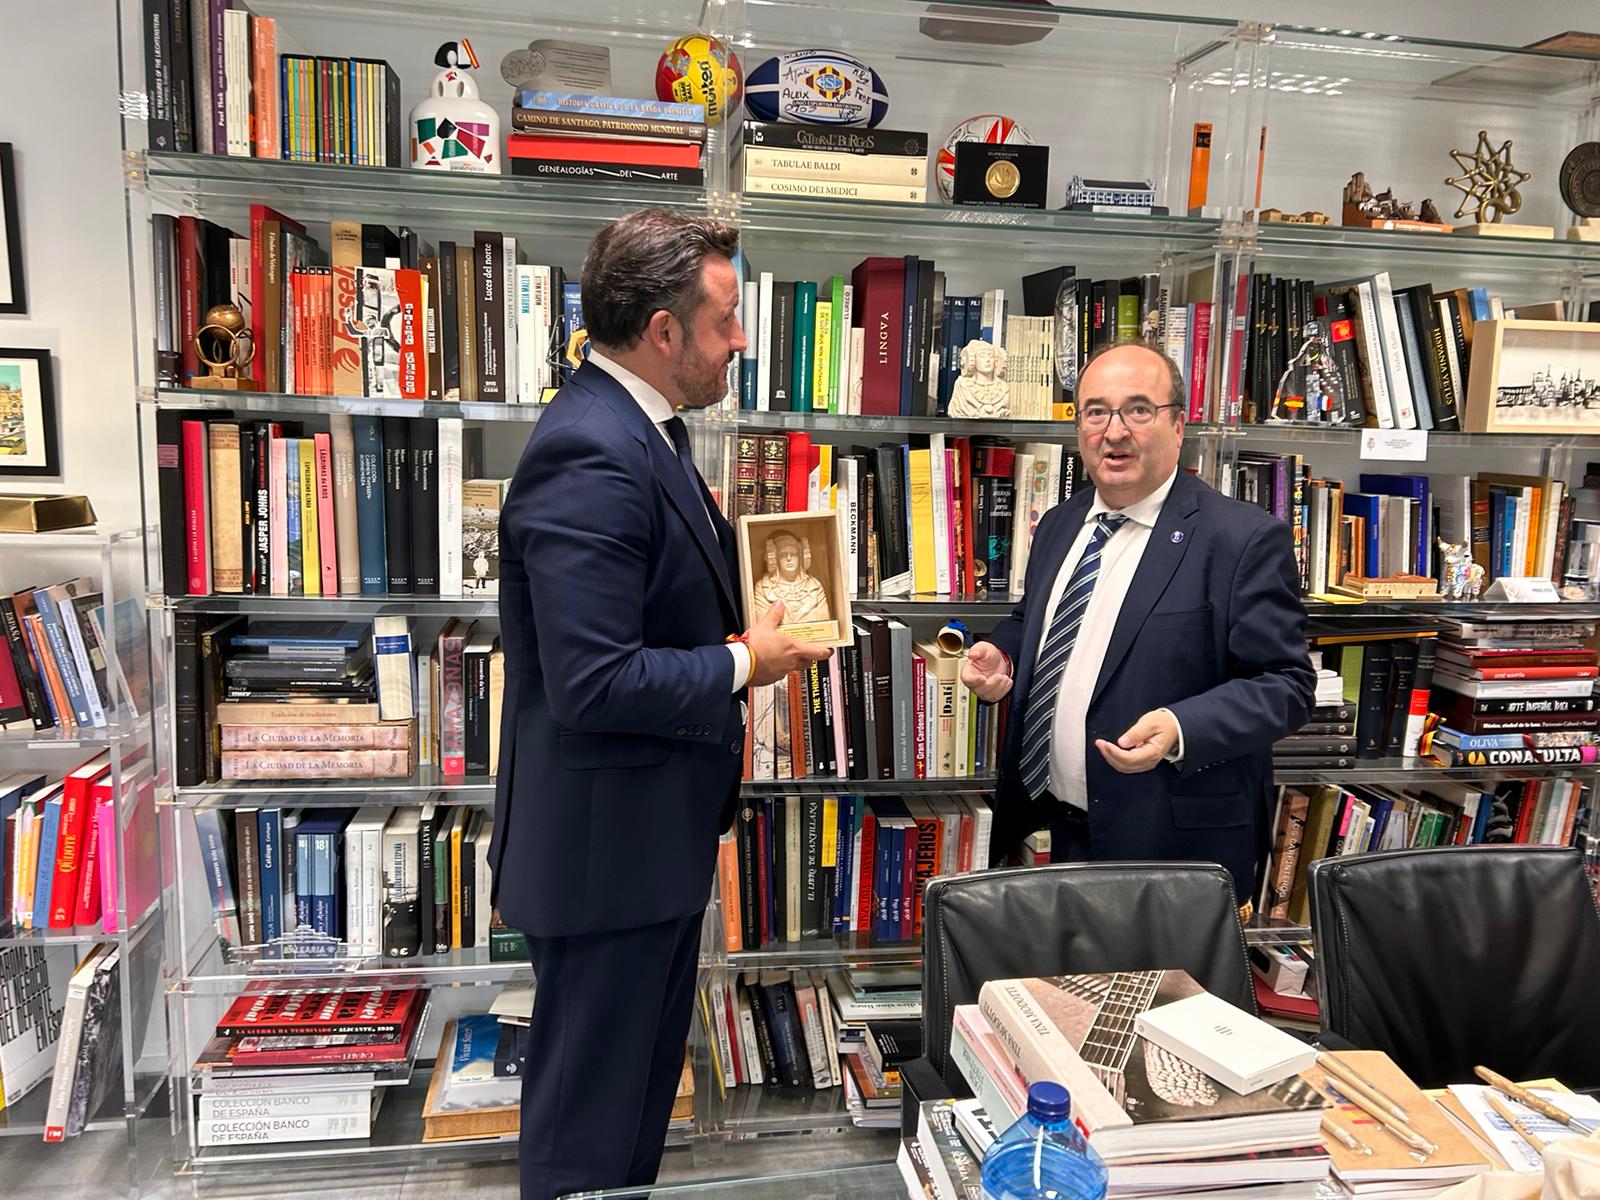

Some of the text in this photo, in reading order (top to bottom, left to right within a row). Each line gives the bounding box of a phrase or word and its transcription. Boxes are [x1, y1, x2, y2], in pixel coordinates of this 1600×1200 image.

[697, 61, 717, 116] molten
[516, 114, 685, 134] CAMINO DE SANTIAGO, PATRIMONIO MUNDIAL
[838, 134, 875, 149] BURGOS
[538, 164, 678, 181] GENEALOGÍAS DEL ARTE
[772, 160, 840, 171] TABULAE BALDI
[771, 183, 858, 196] COSIMO DEI MEDICI
[505, 248, 513, 267] JUAN
[483, 243, 493, 301] Luces del norte
[520, 275, 530, 314] MARUJA MALLO
[1158, 289, 1168, 339] MANHATTAN,
[880, 311, 890, 364] LINGVA
[1434, 328, 1454, 405] HISPANIA VETUS
[258, 489, 268, 554] JASPER JOHNS
[6, 611, 20, 642] ESPAÑA
[813, 698, 821, 714] THE
[943, 686, 953, 714] Dalí
[1507, 703, 1524, 712] ARTE
[916, 712, 925, 742] Cardenal
[248, 734, 259, 742] LA
[261, 733, 295, 742] CIUDAD
[323, 733, 365, 742] MEMORIA
[1470, 739, 1499, 747] OLIVA
[917, 743, 925, 760] Gran
[246, 761, 258, 769] LA
[259, 760, 293, 769] CIUDAD
[322, 760, 363, 769] MEMORIA
[88, 829, 99, 858] Homenaje
[299, 840, 305, 848] 18
[315, 840, 324, 850] 18
[807, 802, 817, 901] EL LIBRO DE SANTILLANA
[60, 835, 76, 872] QUIJOTE
[1279, 819, 1300, 898] LOS CARPINTEROS
[460, 1028, 473, 1061] Vivian Suter
[213, 1096, 310, 1108] COLECCIÓN BANCO
[213, 1106, 270, 1118] DE ESPAÑA
[212, 1120, 310, 1133] COLECCIÓN BANCO
